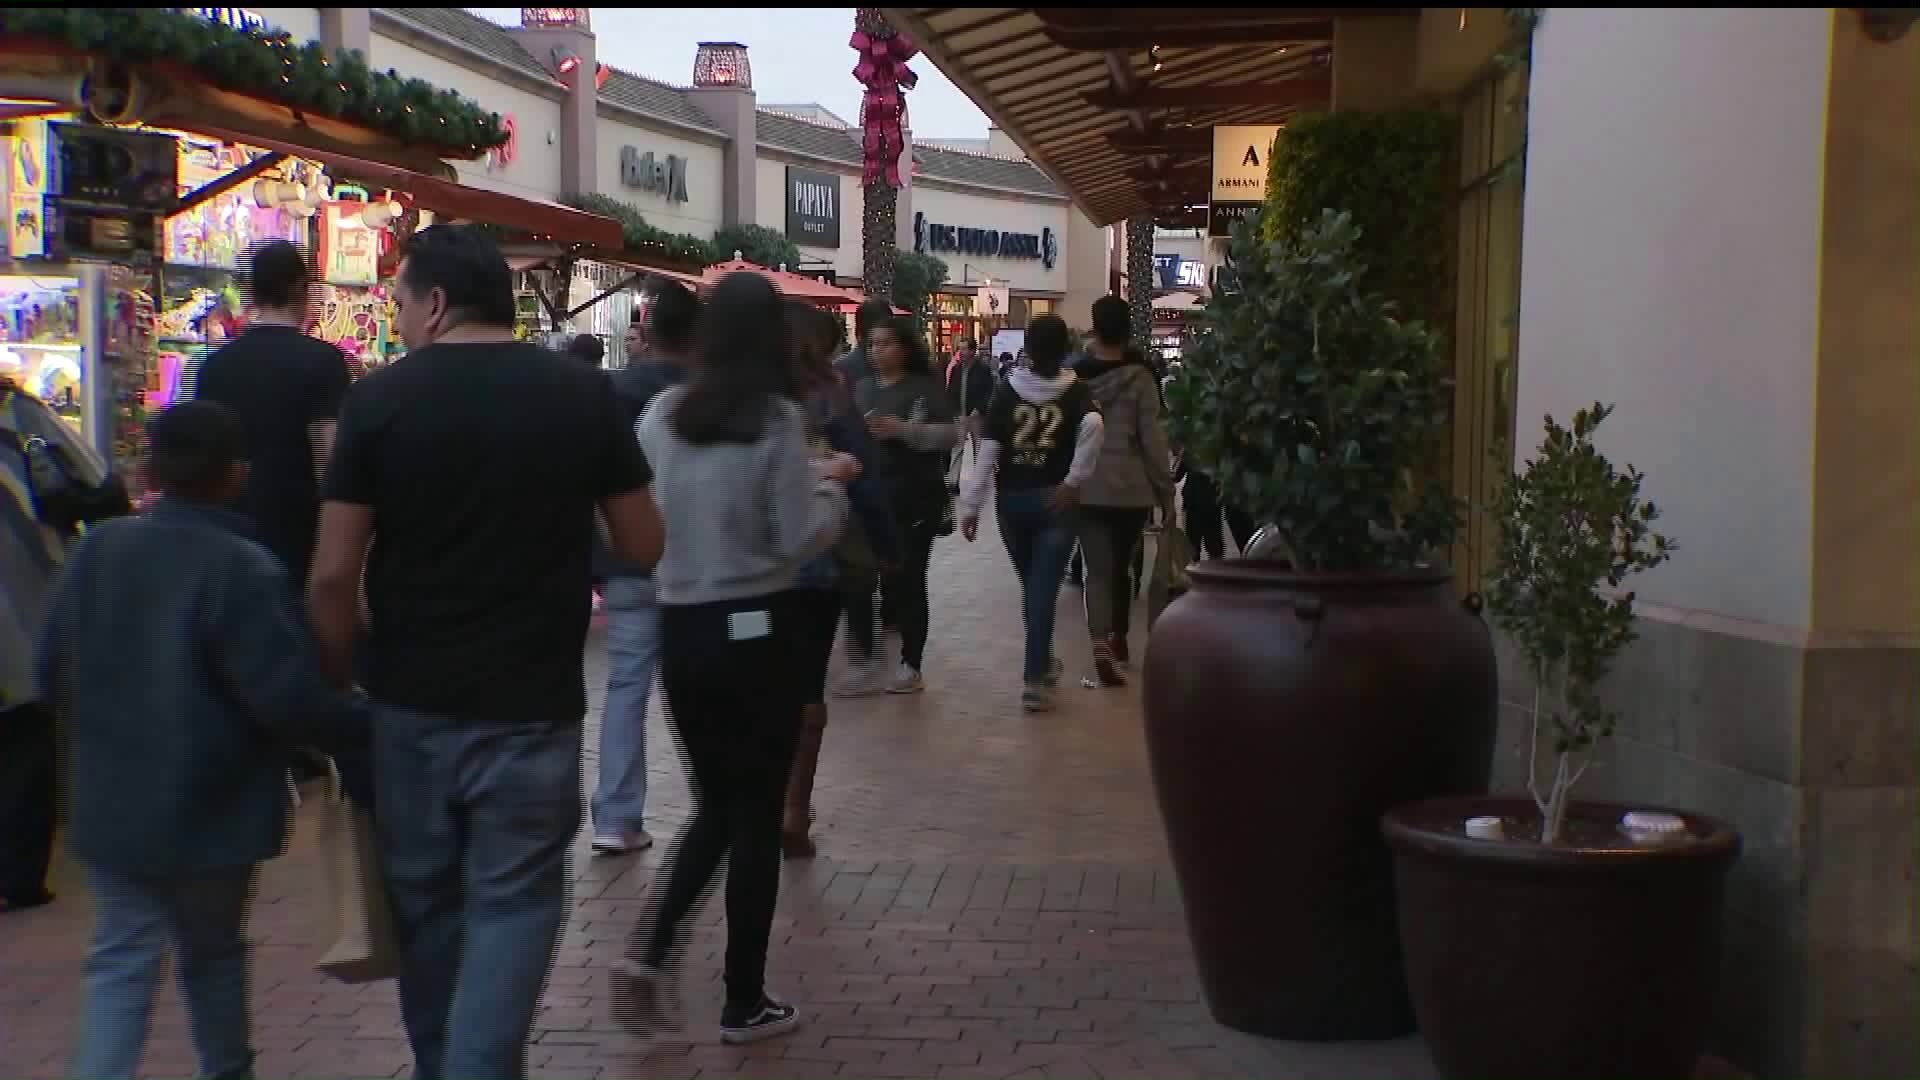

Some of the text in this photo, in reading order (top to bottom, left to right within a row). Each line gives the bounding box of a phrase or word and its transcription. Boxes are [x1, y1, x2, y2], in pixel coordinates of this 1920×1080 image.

[1218, 178, 1259, 188] ARMANI
[795, 181, 832, 218] PAPAYA
[1216, 207, 1246, 216] ANN
[1012, 405, 1063, 448] 22
